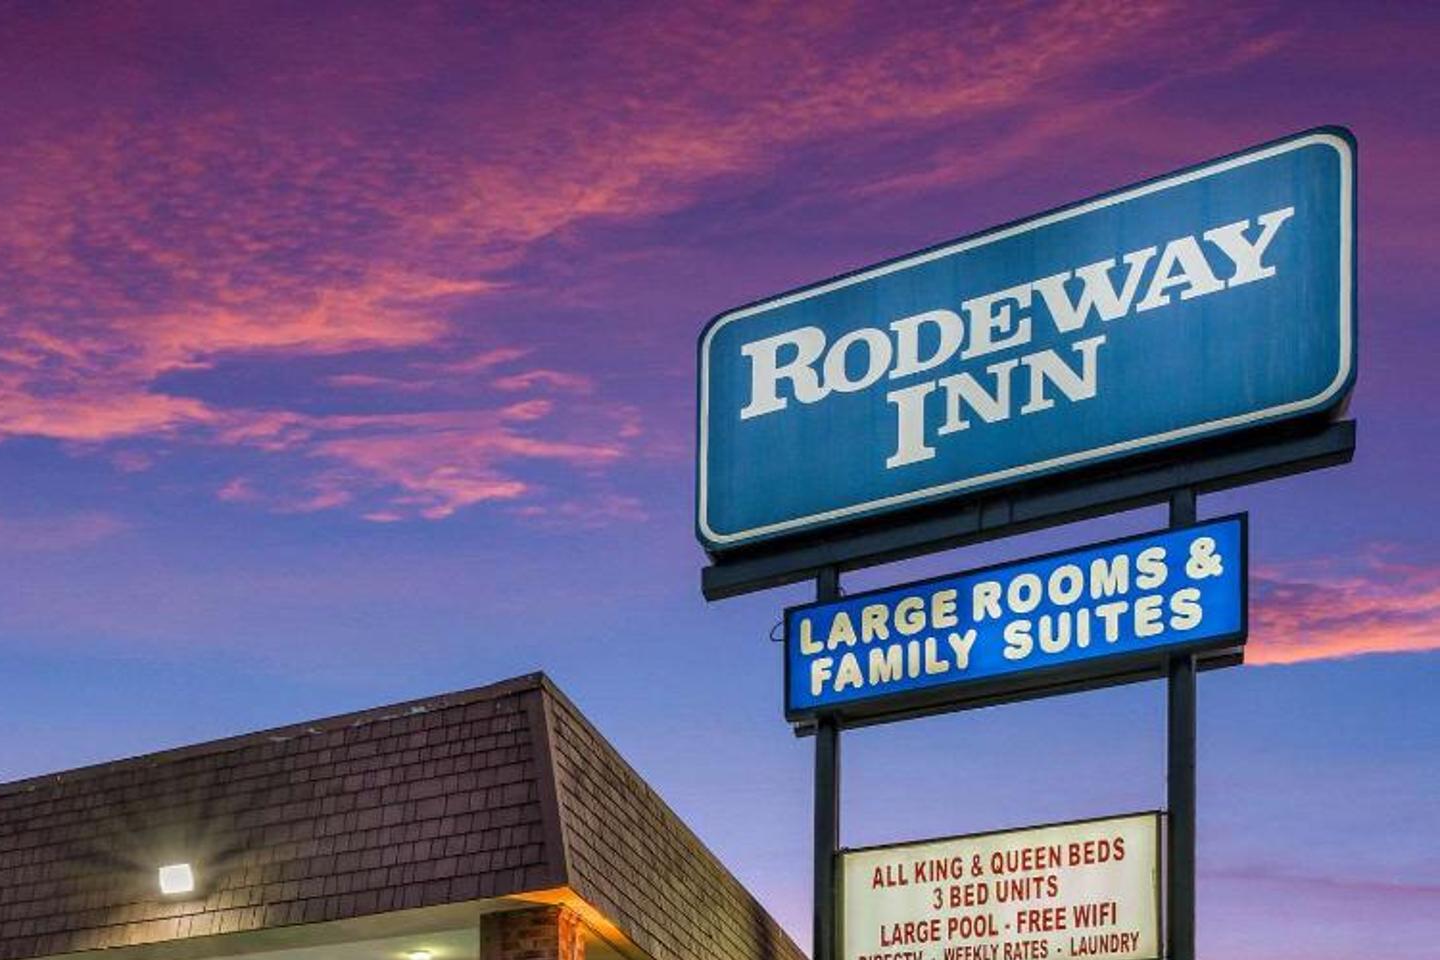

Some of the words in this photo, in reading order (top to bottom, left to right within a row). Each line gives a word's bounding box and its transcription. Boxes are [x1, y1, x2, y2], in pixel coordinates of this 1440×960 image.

[740, 207, 1295, 420] RODEWAY
[886, 335, 1106, 469] INN
[799, 589, 959, 655] LARGE
[972, 547, 1168, 622] ROOMS
[1186, 537, 1224, 579] &
[810, 629, 978, 696] FAMILY
[1003, 588, 1203, 660] SUITES
[872, 863, 909, 889] ALL
[914, 857, 964, 884] KING
[971, 853, 984, 877] &
[990, 844, 1061, 875] QUEEN
[1068, 836, 1126, 867] BEDS
[932, 887, 944, 910] 3
[949, 883, 989, 908] BED
[996, 875, 1059, 902] UNITS
[880, 919, 942, 947] LARGE
[948, 914, 1000, 940] POOL
[1016, 907, 1067, 934] FREE
[1073, 902, 1117, 928] WIFI
[1070, 931, 1140, 956] LAUNDRY
